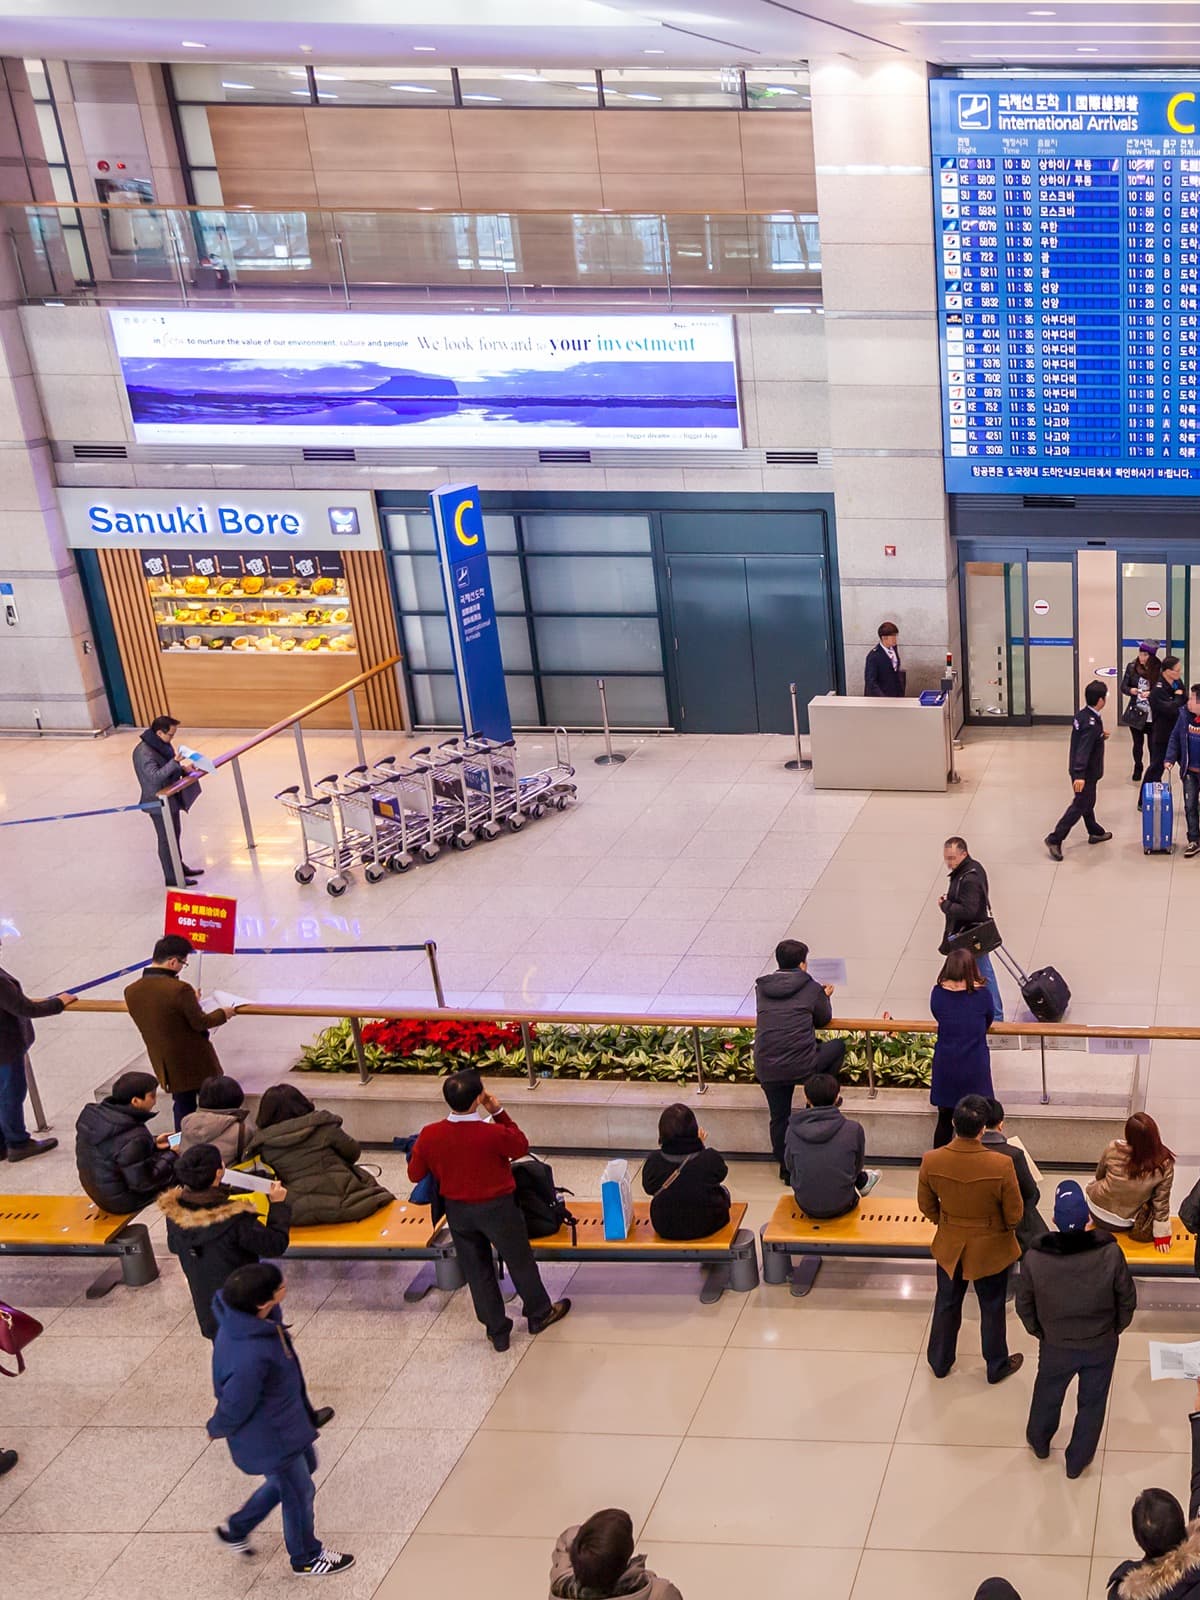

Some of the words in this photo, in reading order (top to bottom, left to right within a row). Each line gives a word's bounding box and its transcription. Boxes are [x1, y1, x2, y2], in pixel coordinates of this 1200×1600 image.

[998, 93, 1034, 112] 국제선
[1035, 93, 1060, 111] 도착
[1166, 92, 1196, 134] C
[998, 115, 1083, 131] International
[1087, 115, 1139, 131] Arrivals
[957, 147, 976, 155] Flight
[1003, 147, 1020, 155] Time
[1038, 147, 1056, 155] From
[1126, 148, 1142, 156] New
[1144, 148, 1161, 156] Time
[1163, 148, 1176, 156] Exit
[1163, 176, 1171, 186] C
[1040, 191, 1074, 201] 모스크바
[1041, 207, 1074, 216] 모스크바
[1043, 315, 1075, 325] 아부다비
[1043, 330, 1075, 339] 아부다비
[228, 337, 240, 345] the
[241, 337, 262, 346] value
[263, 337, 272, 345] of
[273, 338, 286, 346] our
[368, 338, 382, 347] and
[383, 338, 409, 350] people
[417, 335, 441, 351] We
[444, 334, 473, 351] look
[479, 334, 533, 352] forward
[549, 337, 591, 356] your
[596, 333, 697, 352] investment
[1043, 345, 1075, 354] 아부다비
[1044, 360, 1076, 368] 아부다비
[1163, 389, 1170, 399] C
[1045, 404, 1069, 412] 나고야
[1045, 418, 1069, 426] 나고야
[1045, 432, 1069, 441] 나고야
[1046, 447, 1069, 455] 나고야
[88, 505, 208, 534] Sanuki
[218, 507, 300, 535] Bore
[454, 500, 479, 546] C
